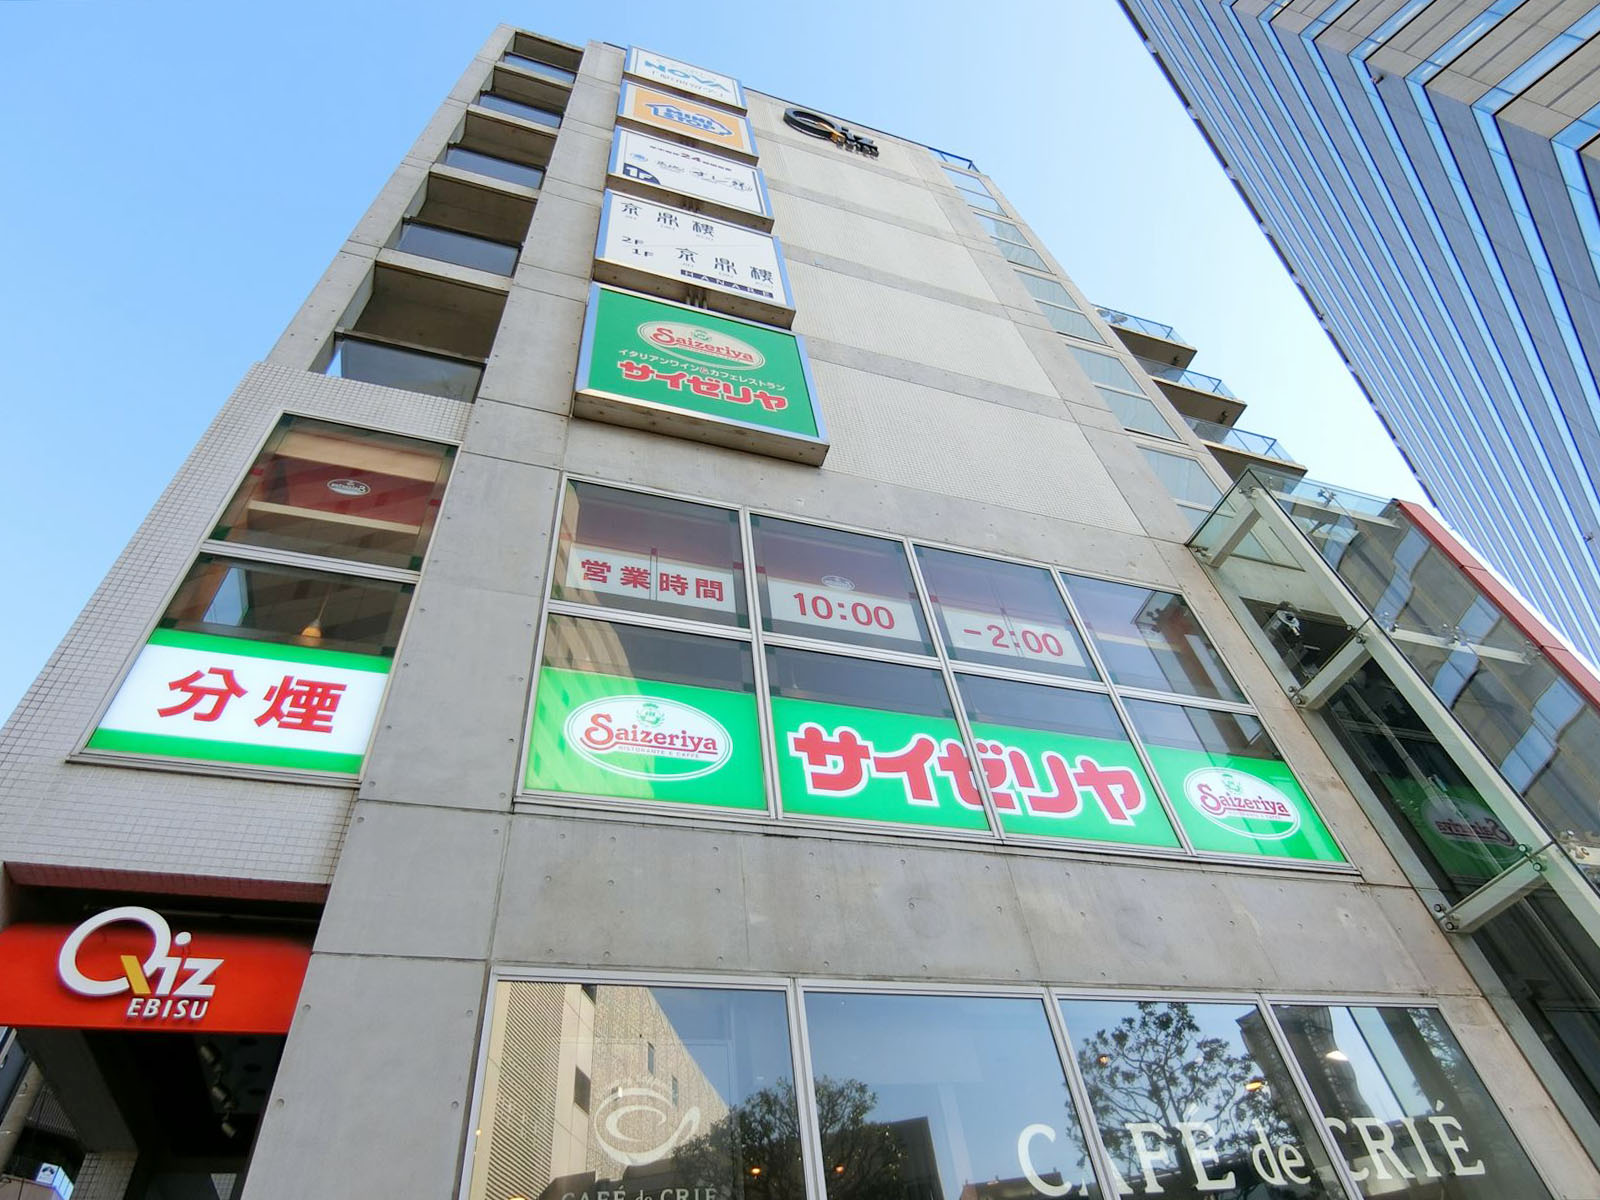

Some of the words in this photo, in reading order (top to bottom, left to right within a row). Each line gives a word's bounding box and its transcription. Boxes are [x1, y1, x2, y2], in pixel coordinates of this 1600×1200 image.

[644, 60, 729, 92] NOVA
[621, 235, 644, 245] 2F
[632, 248, 655, 257] 1F
[650, 327, 754, 362] Saizeriya
[617, 359, 789, 413] サイゼリヤ
[580, 559, 724, 602] 営業時間
[793, 592, 895, 630] 10:00
[157, 667, 347, 734] 分煙
[580, 713, 718, 755] Saizeriya
[787, 721, 1146, 827] サイゼリヤ
[1197, 783, 1291, 817] Saizeriya
[126, 998, 210, 1019] EBISU
[1252, 1118, 1311, 1185] de
